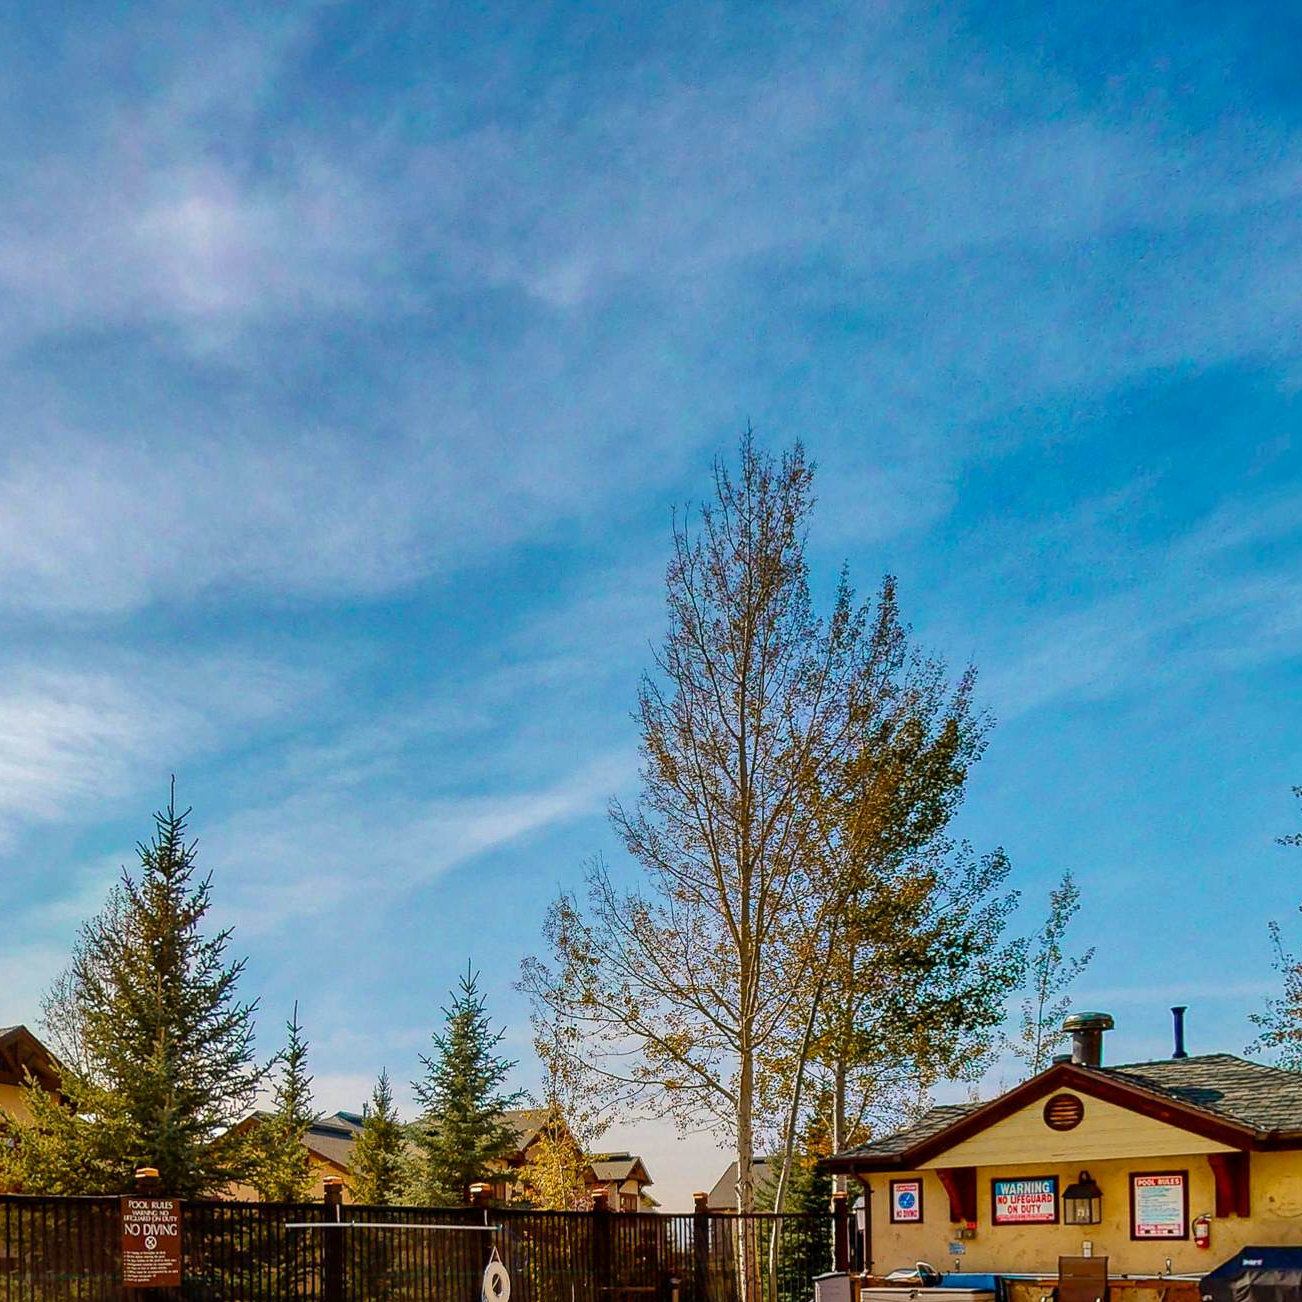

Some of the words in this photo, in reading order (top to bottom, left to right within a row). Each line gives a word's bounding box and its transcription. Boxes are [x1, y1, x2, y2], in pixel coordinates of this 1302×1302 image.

[1000, 1182, 1050, 1194] WARNING
[128, 1200, 149, 1209] POOL
[151, 1201, 174, 1209] RULES
[997, 1196, 1008, 1205] NO
[1010, 1194, 1053, 1204] LIFEGUARD
[1007, 1204, 1018, 1213] ON
[1021, 1204, 1042, 1213] DUTY
[124, 1223, 141, 1236] NO
[143, 1223, 178, 1236] DIVING
